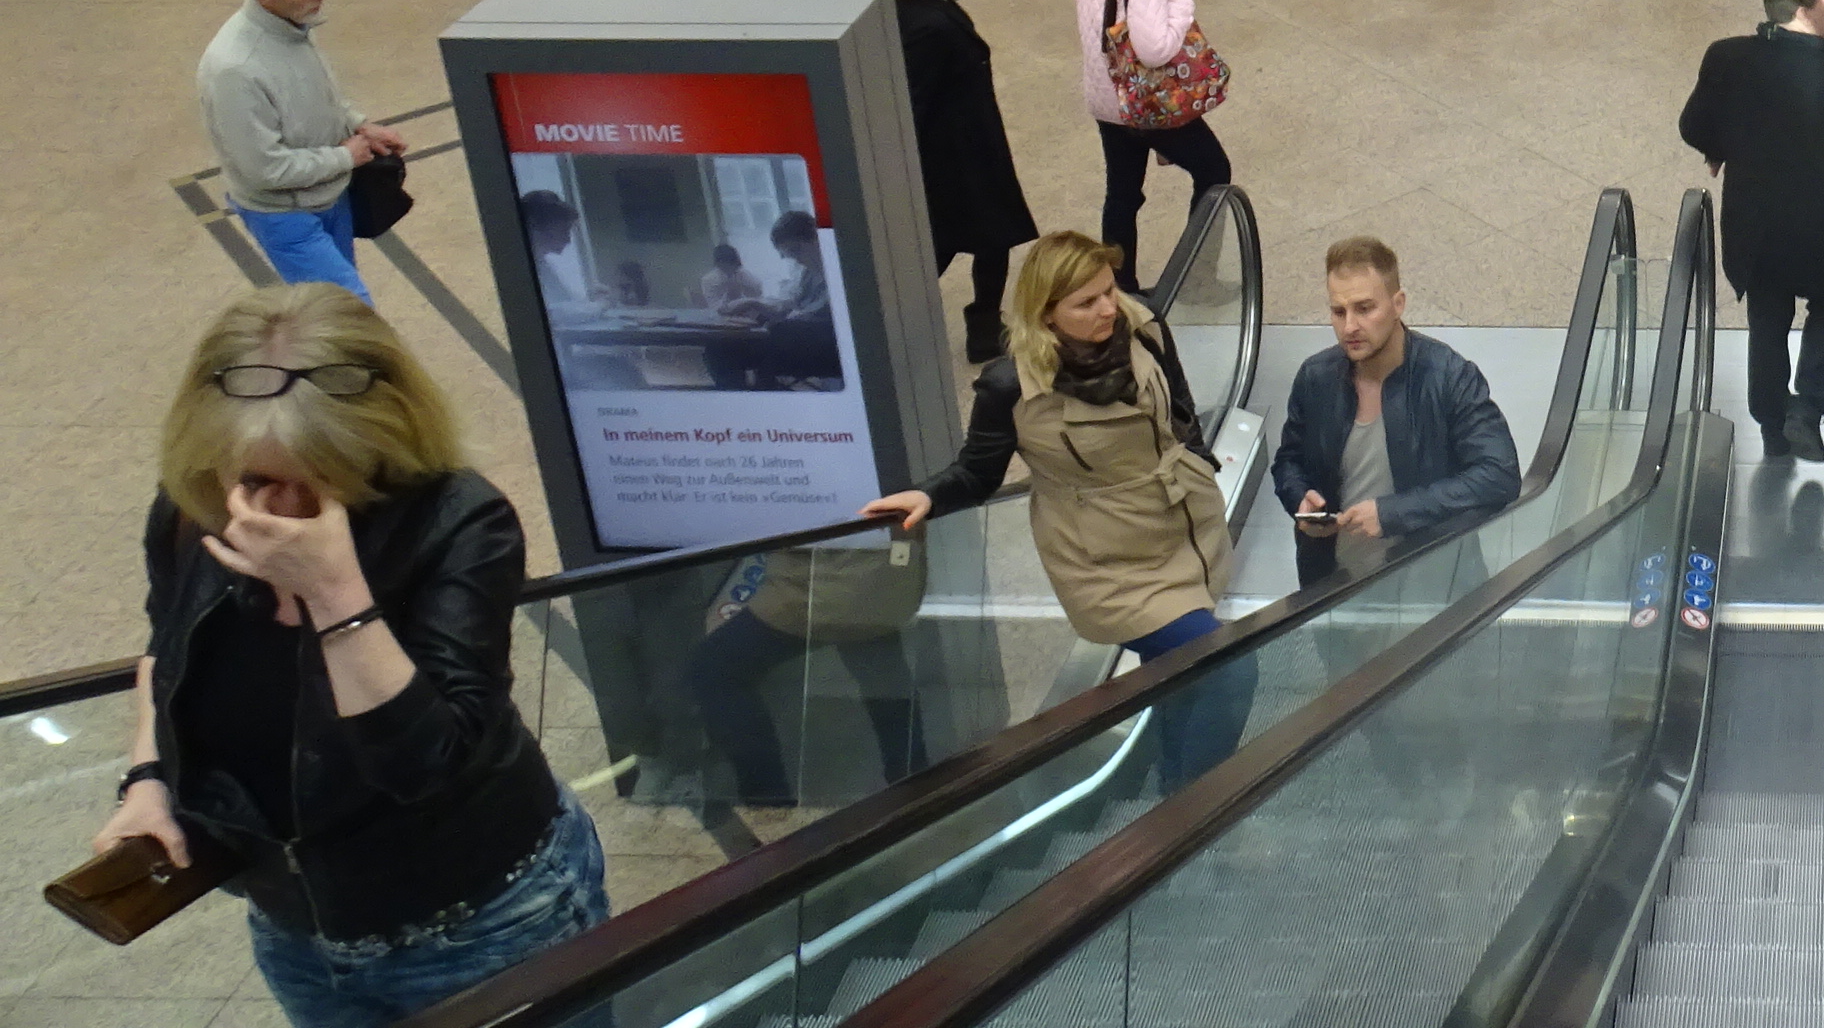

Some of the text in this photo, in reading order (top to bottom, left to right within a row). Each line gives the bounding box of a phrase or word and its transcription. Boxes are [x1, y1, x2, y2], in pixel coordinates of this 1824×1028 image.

[534, 123, 684, 143] MOVIE TIME
[603, 427, 854, 446] In meinem Kopf ein Universum
